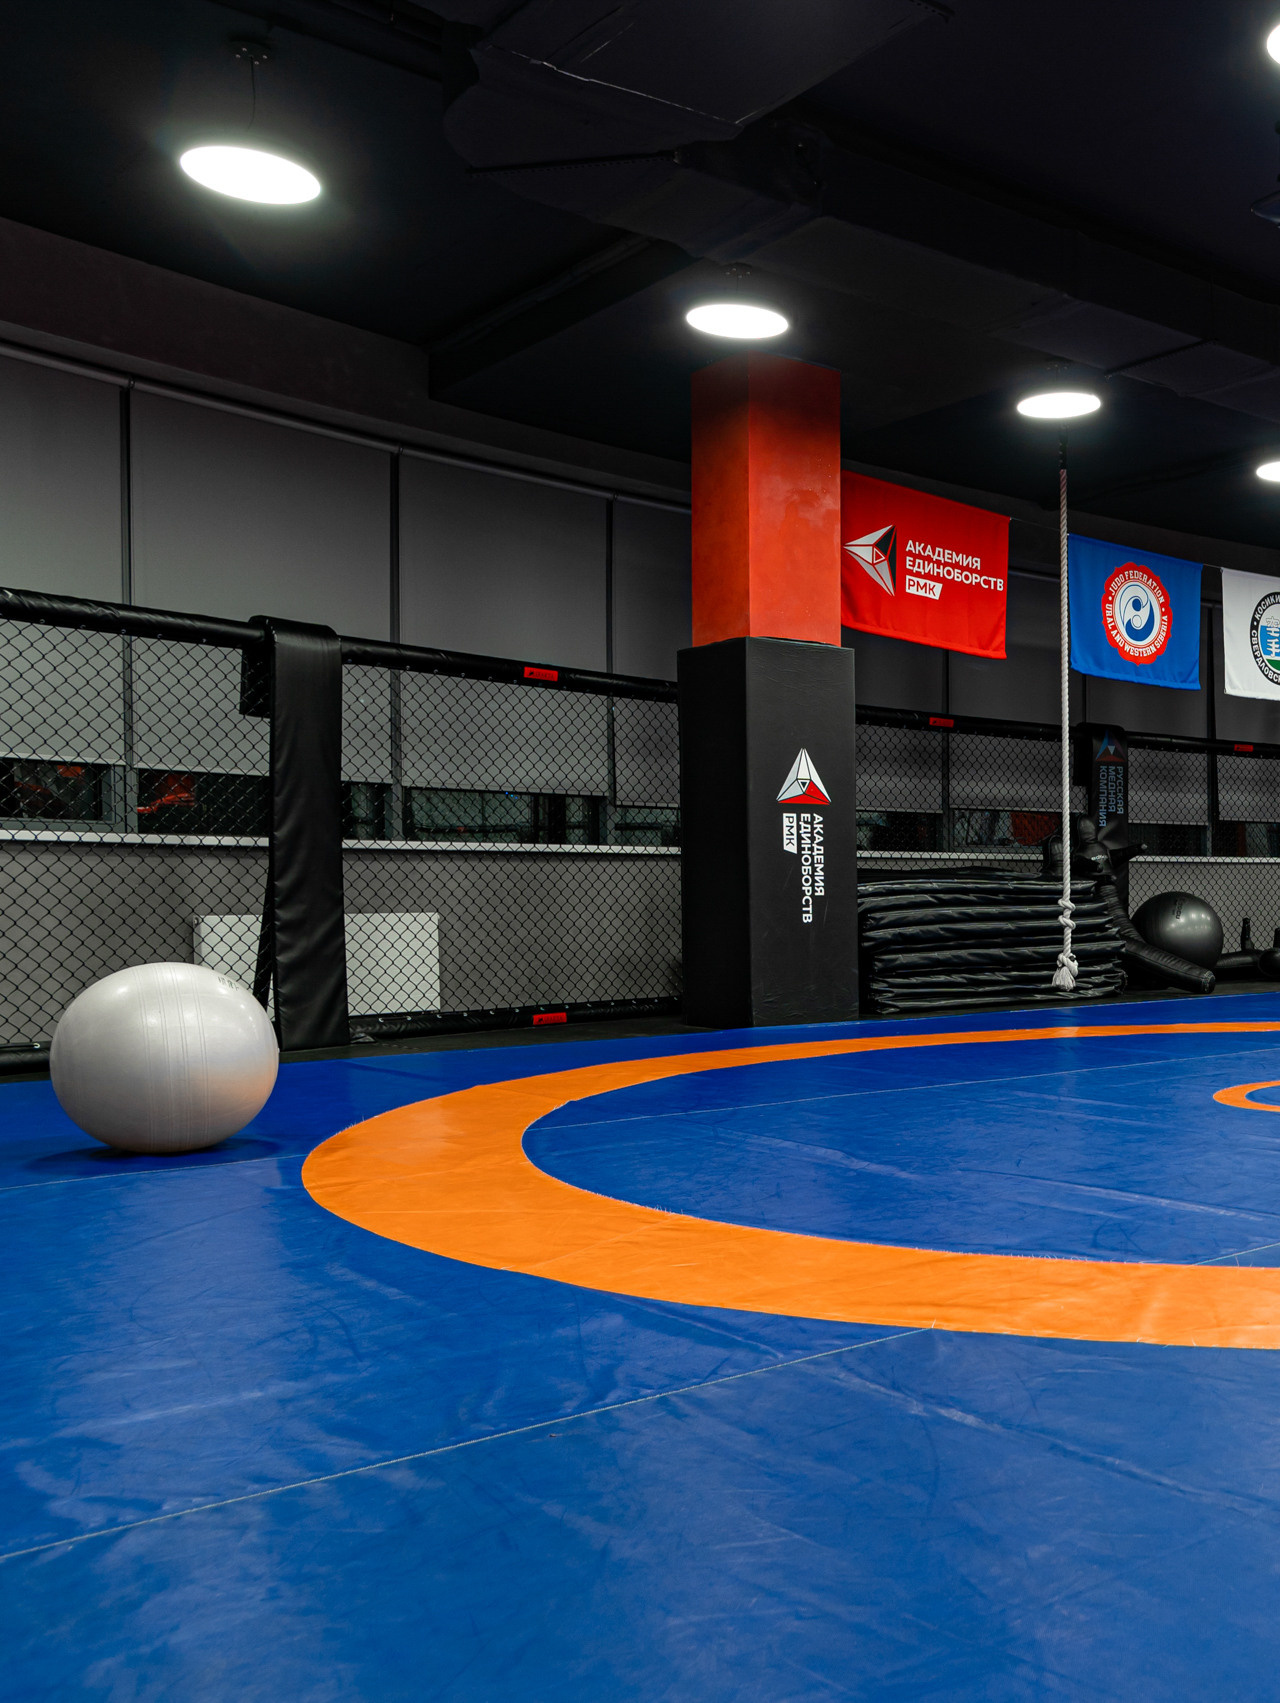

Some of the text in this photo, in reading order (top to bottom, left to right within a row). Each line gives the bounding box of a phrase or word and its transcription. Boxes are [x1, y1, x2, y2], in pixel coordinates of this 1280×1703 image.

[905, 539, 981, 571] АКАДЕМИЯ
[905, 556, 1004, 592] ЕДИНОБОРСТВ
[907, 579, 938, 597] РМК
[1109, 570, 1165, 604] JUDO FEDERATION
[1254, 594, 1280, 621] КОСИКИ
[1105, 603, 1168, 657] URAL AND WESTERN SIBERIA
[1099, 765, 1107, 827] КОМПАНИЯ
[1108, 766, 1116, 812] МЕДНАЯ
[785, 815, 795, 847] РМК
[799, 813, 813, 923] ЕДИНОБОРСТВ
[813, 813, 825, 896] АКАДЕМИЯ
